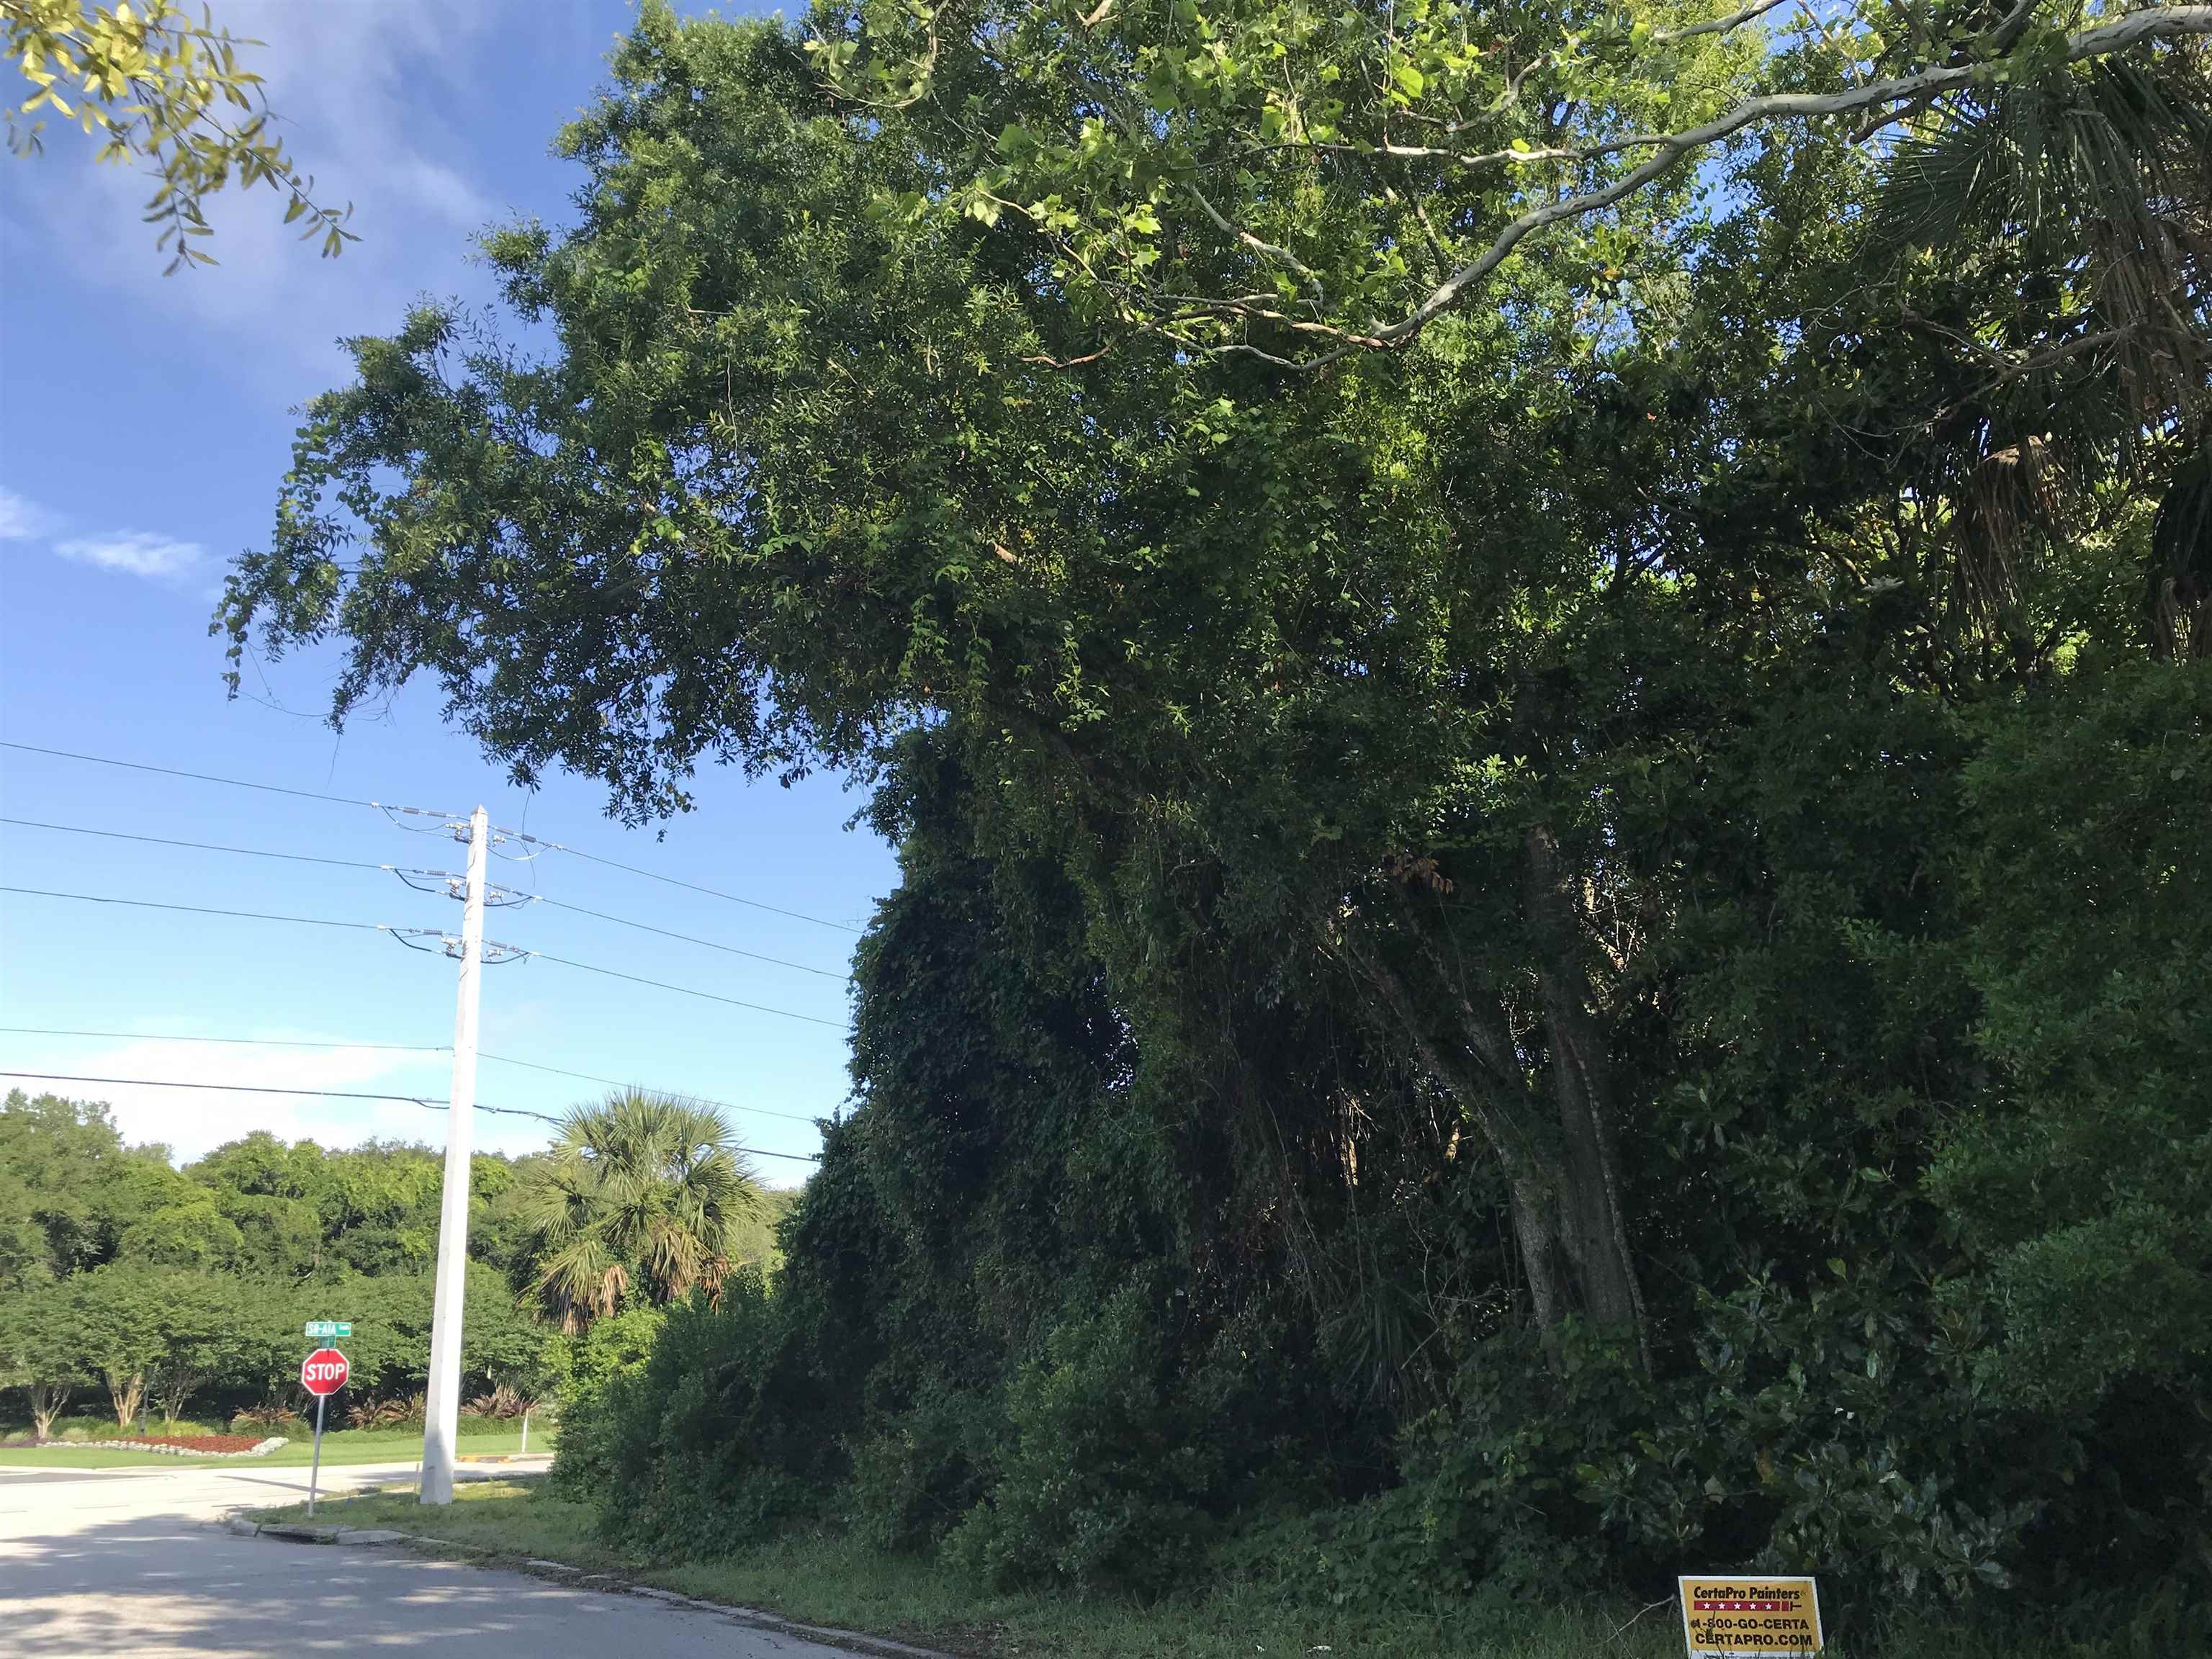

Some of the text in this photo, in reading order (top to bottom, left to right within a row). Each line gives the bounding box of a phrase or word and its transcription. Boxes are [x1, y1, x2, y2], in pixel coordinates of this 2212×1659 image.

[306, 1363, 345, 1380] STOP
[1694, 1586, 1800, 1599] CertaPro Painters
[1695, 1619, 1809, 1629] 1-800-GO-CERTA
[1695, 1633, 1812, 1645] CERTAPRO.COM
